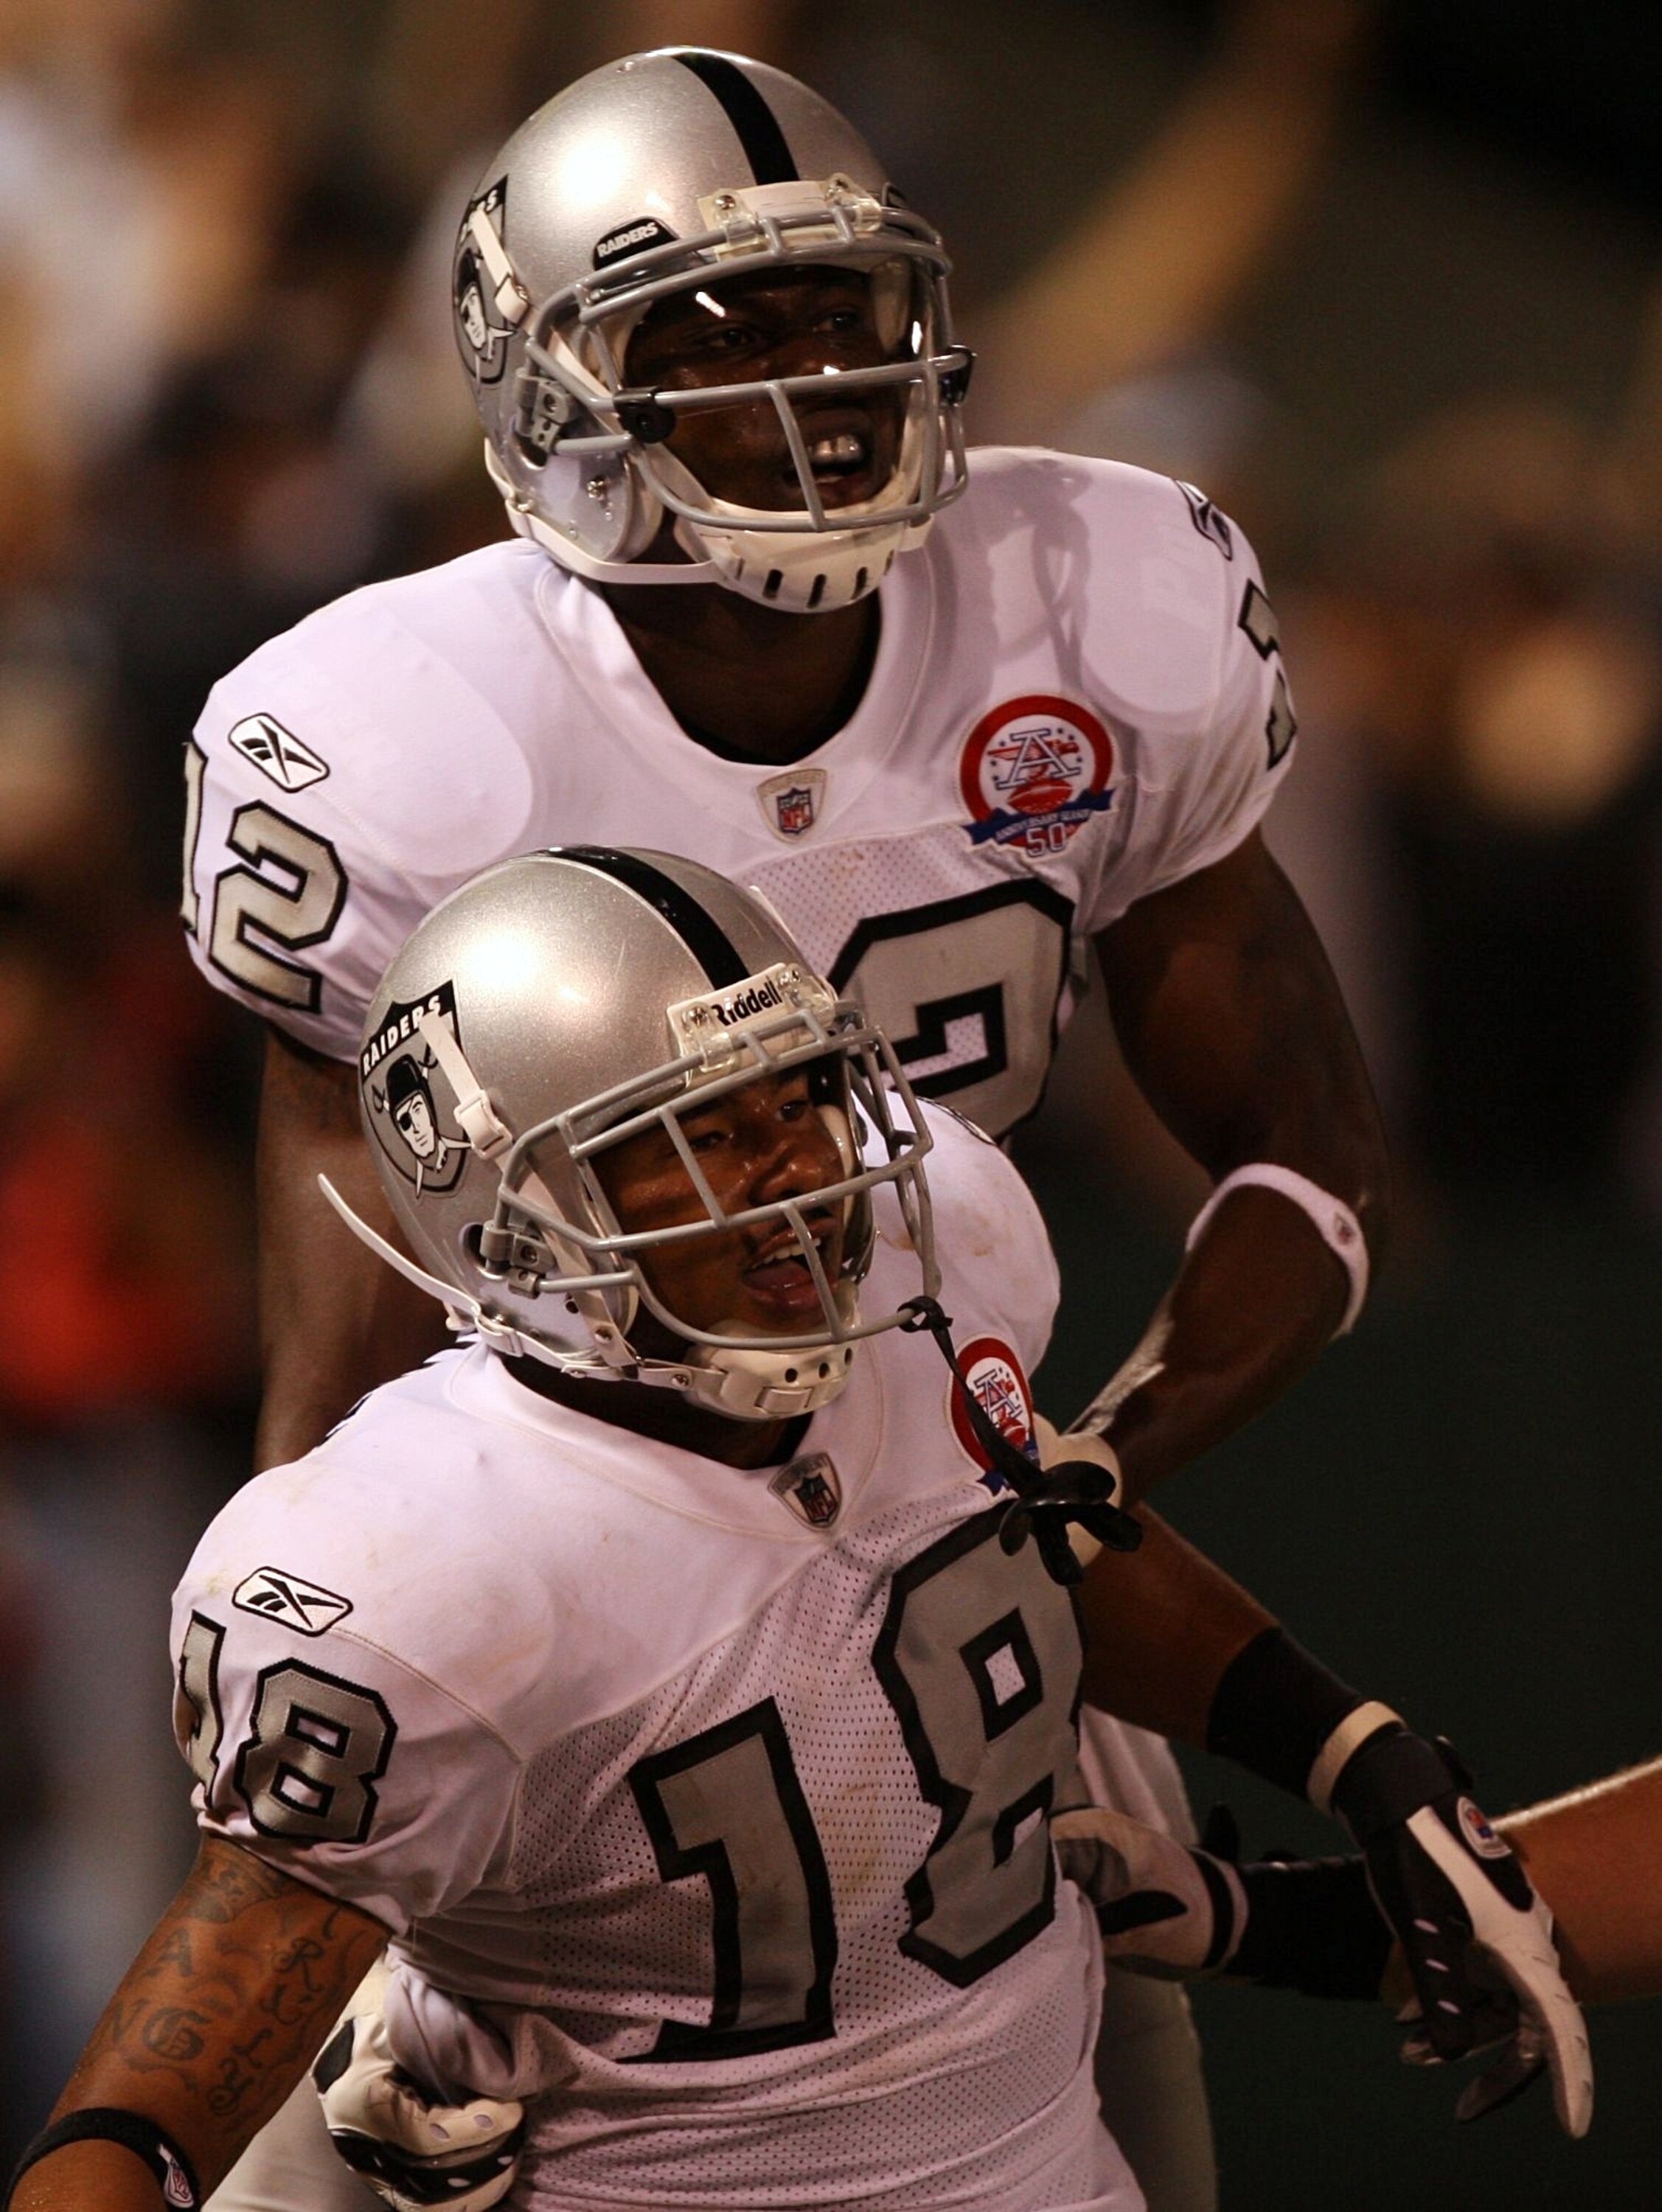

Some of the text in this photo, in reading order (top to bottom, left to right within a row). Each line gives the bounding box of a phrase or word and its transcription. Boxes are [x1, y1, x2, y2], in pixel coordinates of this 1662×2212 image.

[597, 222, 658, 258] RAIDERS
[181, 742, 349, 1015] 12
[363, 995, 441, 1076] RAIDERS
[711, 975, 783, 1026] Riddell
[179, 1609, 397, 1843] 18
[614, 1501, 1089, 2064] 18
